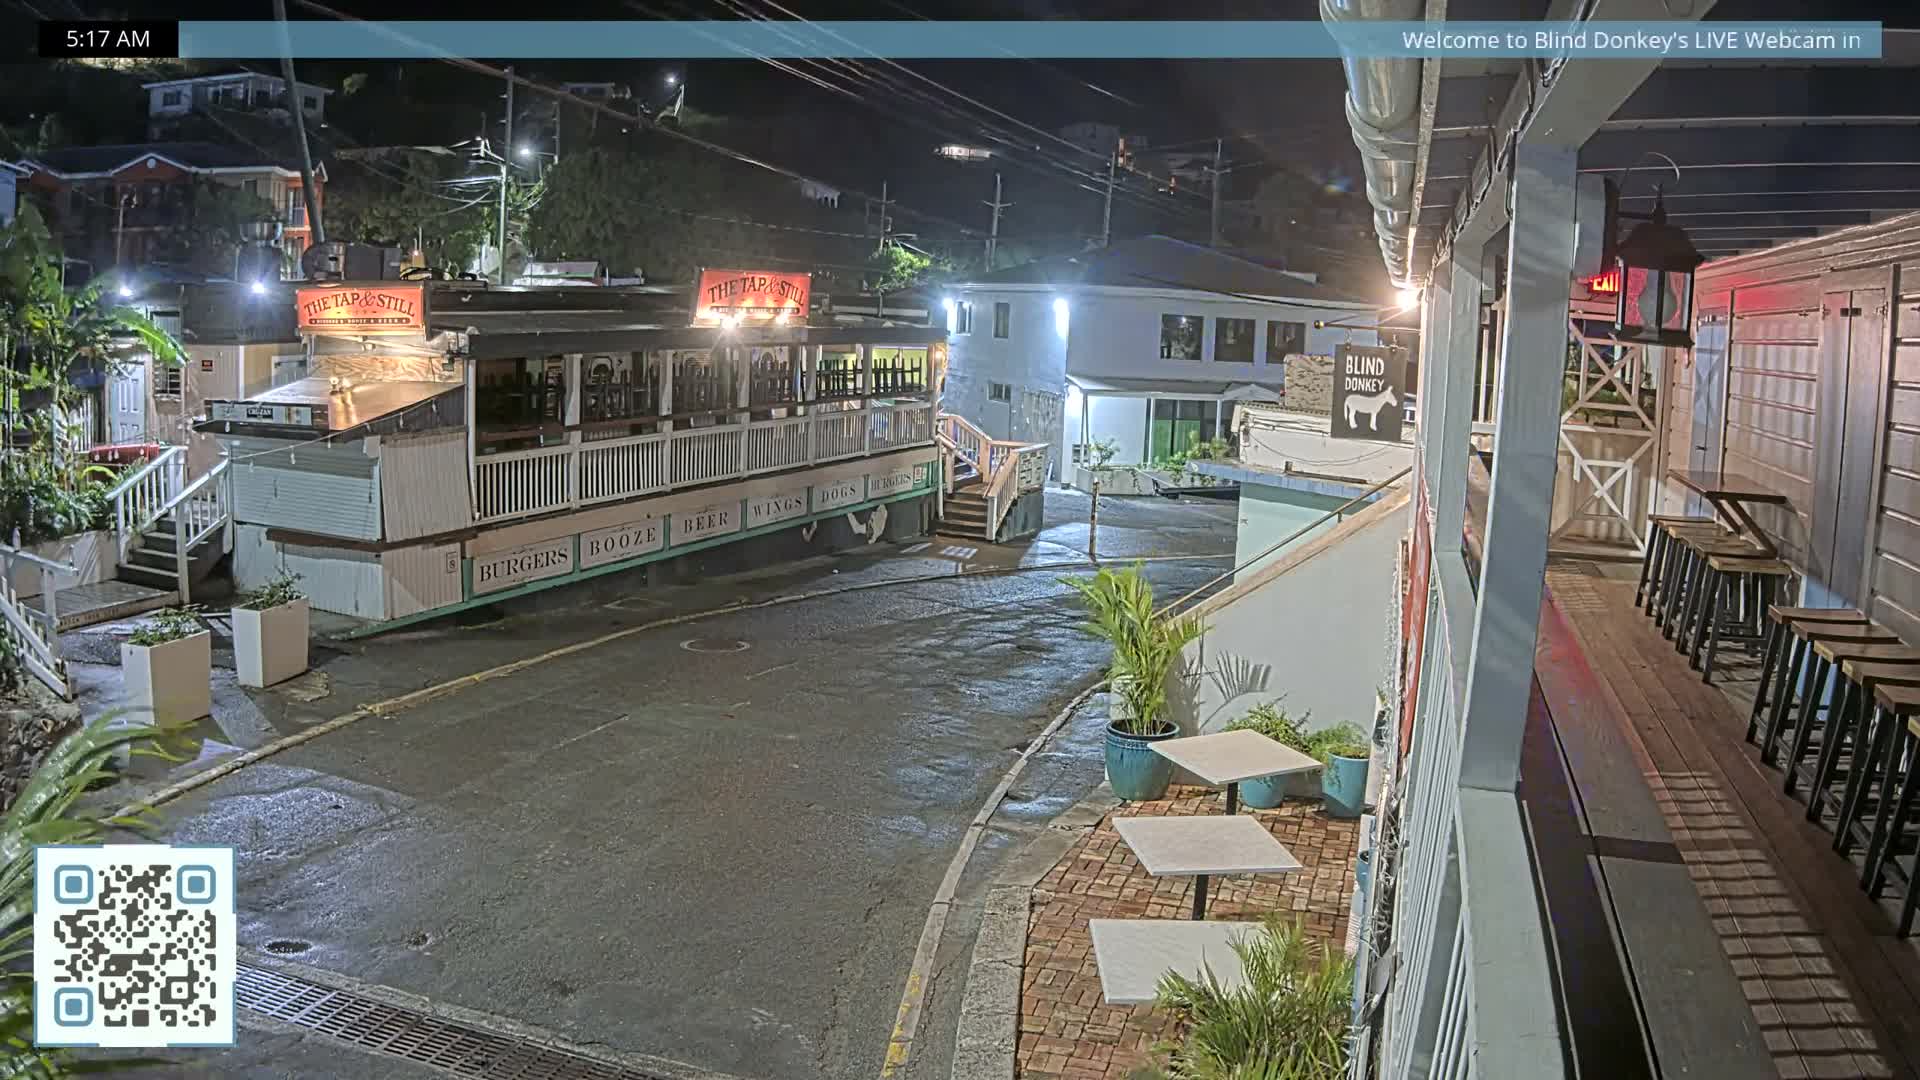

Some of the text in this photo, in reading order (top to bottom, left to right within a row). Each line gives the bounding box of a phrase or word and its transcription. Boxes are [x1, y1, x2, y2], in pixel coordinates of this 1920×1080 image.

[708, 280, 738, 303] THE
[741, 276, 768, 293] TAP
[779, 280, 805, 306] STILL
[304, 290, 415, 317] THE TAP & STILL
[1345, 355, 1385, 376] BLIND
[1344, 376, 1385, 392] DONKEY
[870, 472, 912, 491] BURGERS
[821, 485, 857, 503] DOGS
[752, 496, 803, 518] WINGS
[683, 511, 729, 534] BEER
[589, 527, 657, 557] BOOZE
[479, 548, 569, 582] BURGERS
